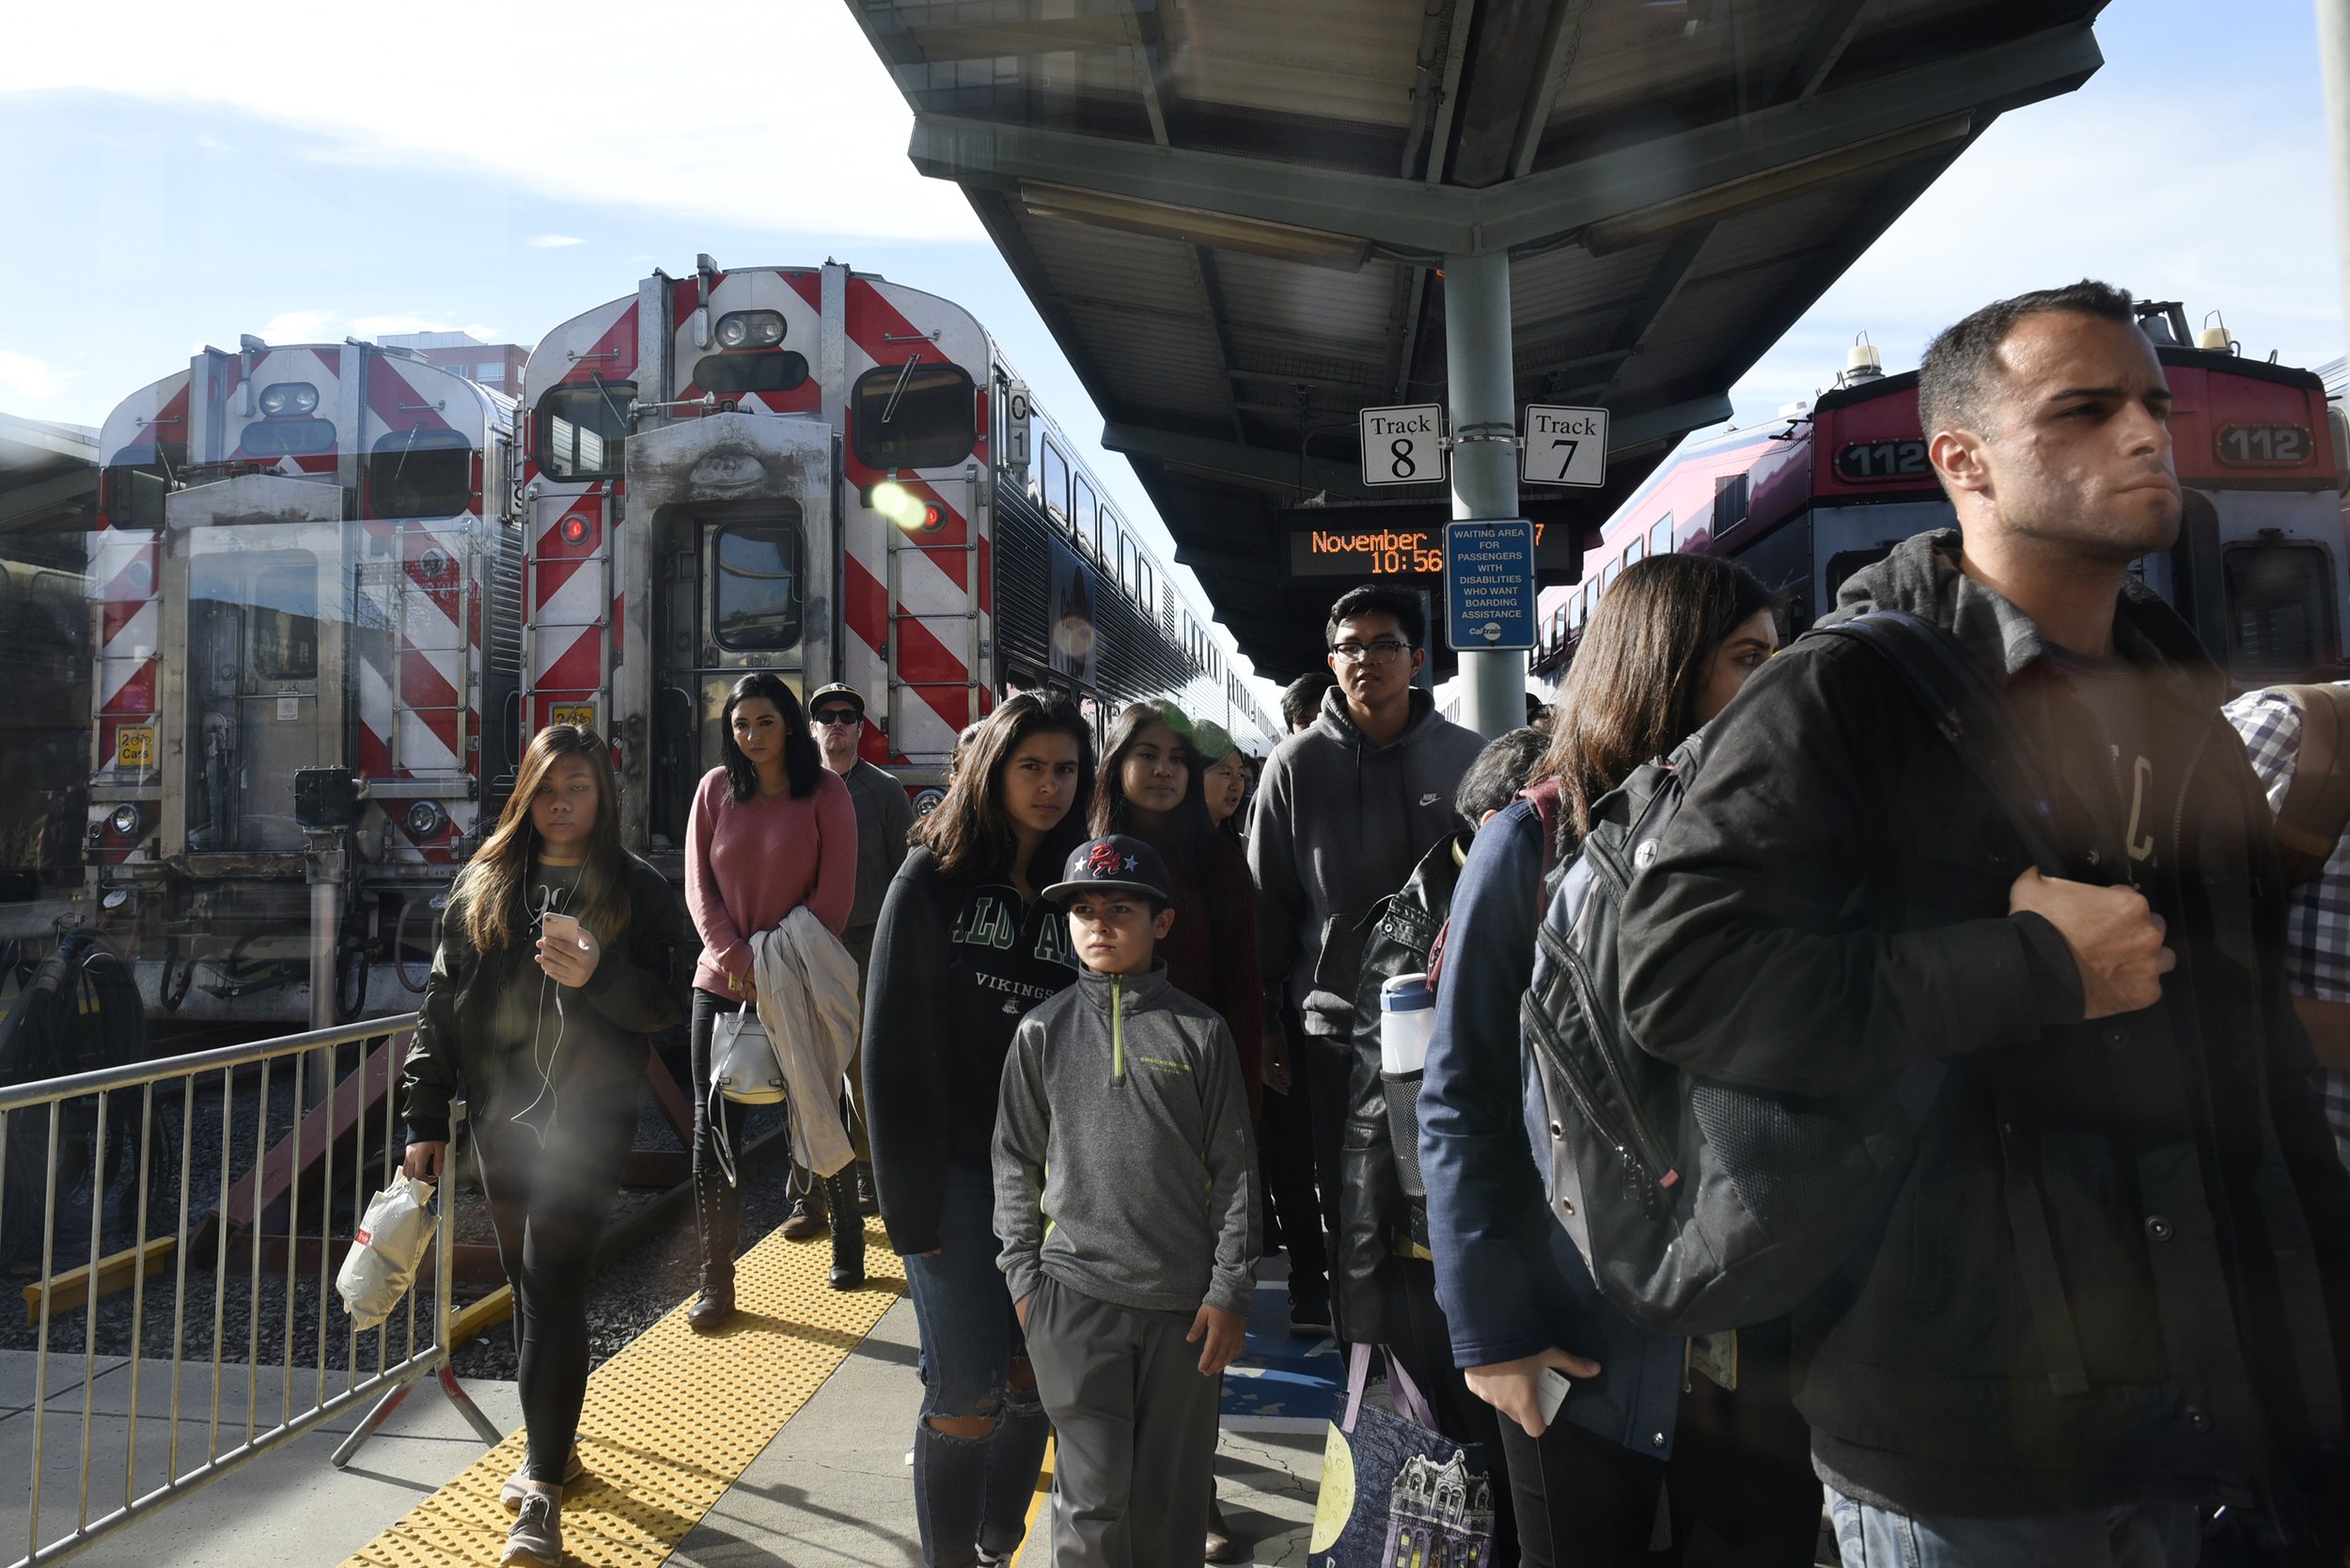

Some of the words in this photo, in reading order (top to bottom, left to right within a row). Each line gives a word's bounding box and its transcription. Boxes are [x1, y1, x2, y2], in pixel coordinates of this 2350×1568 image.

[1371, 415, 1432, 435] Track
[1535, 415, 1597, 435] Track
[2228, 429, 2301, 460] 112
[1391, 438, 1416, 478] 8
[1551, 439, 1579, 479] 7
[1848, 442, 1926, 476] 112
[1312, 528, 1428, 554] November
[1454, 529, 1496, 539] WAITING
[1497, 528, 1525, 538] AREA
[1479, 541, 1500, 550] FOR
[1371, 549, 1443, 574] 10:56
[1458, 551, 1523, 562] PASSENGERS
[1478, 564, 1503, 572] WITH
[1459, 574, 1522, 585] DISABILITIES
[1464, 587, 1488, 596] WHO
[1490, 586, 1519, 595] WANT
[1465, 598, 1518, 607] BOARDING
[1461, 609, 1522, 619] ASSISTANCE
[1468, 626, 1502, 635] Caltrain
[122, 748, 149, 760] Cars
[1034, 913, 1080, 972] AL
[975, 971, 1055, 1000] VIKINGS
